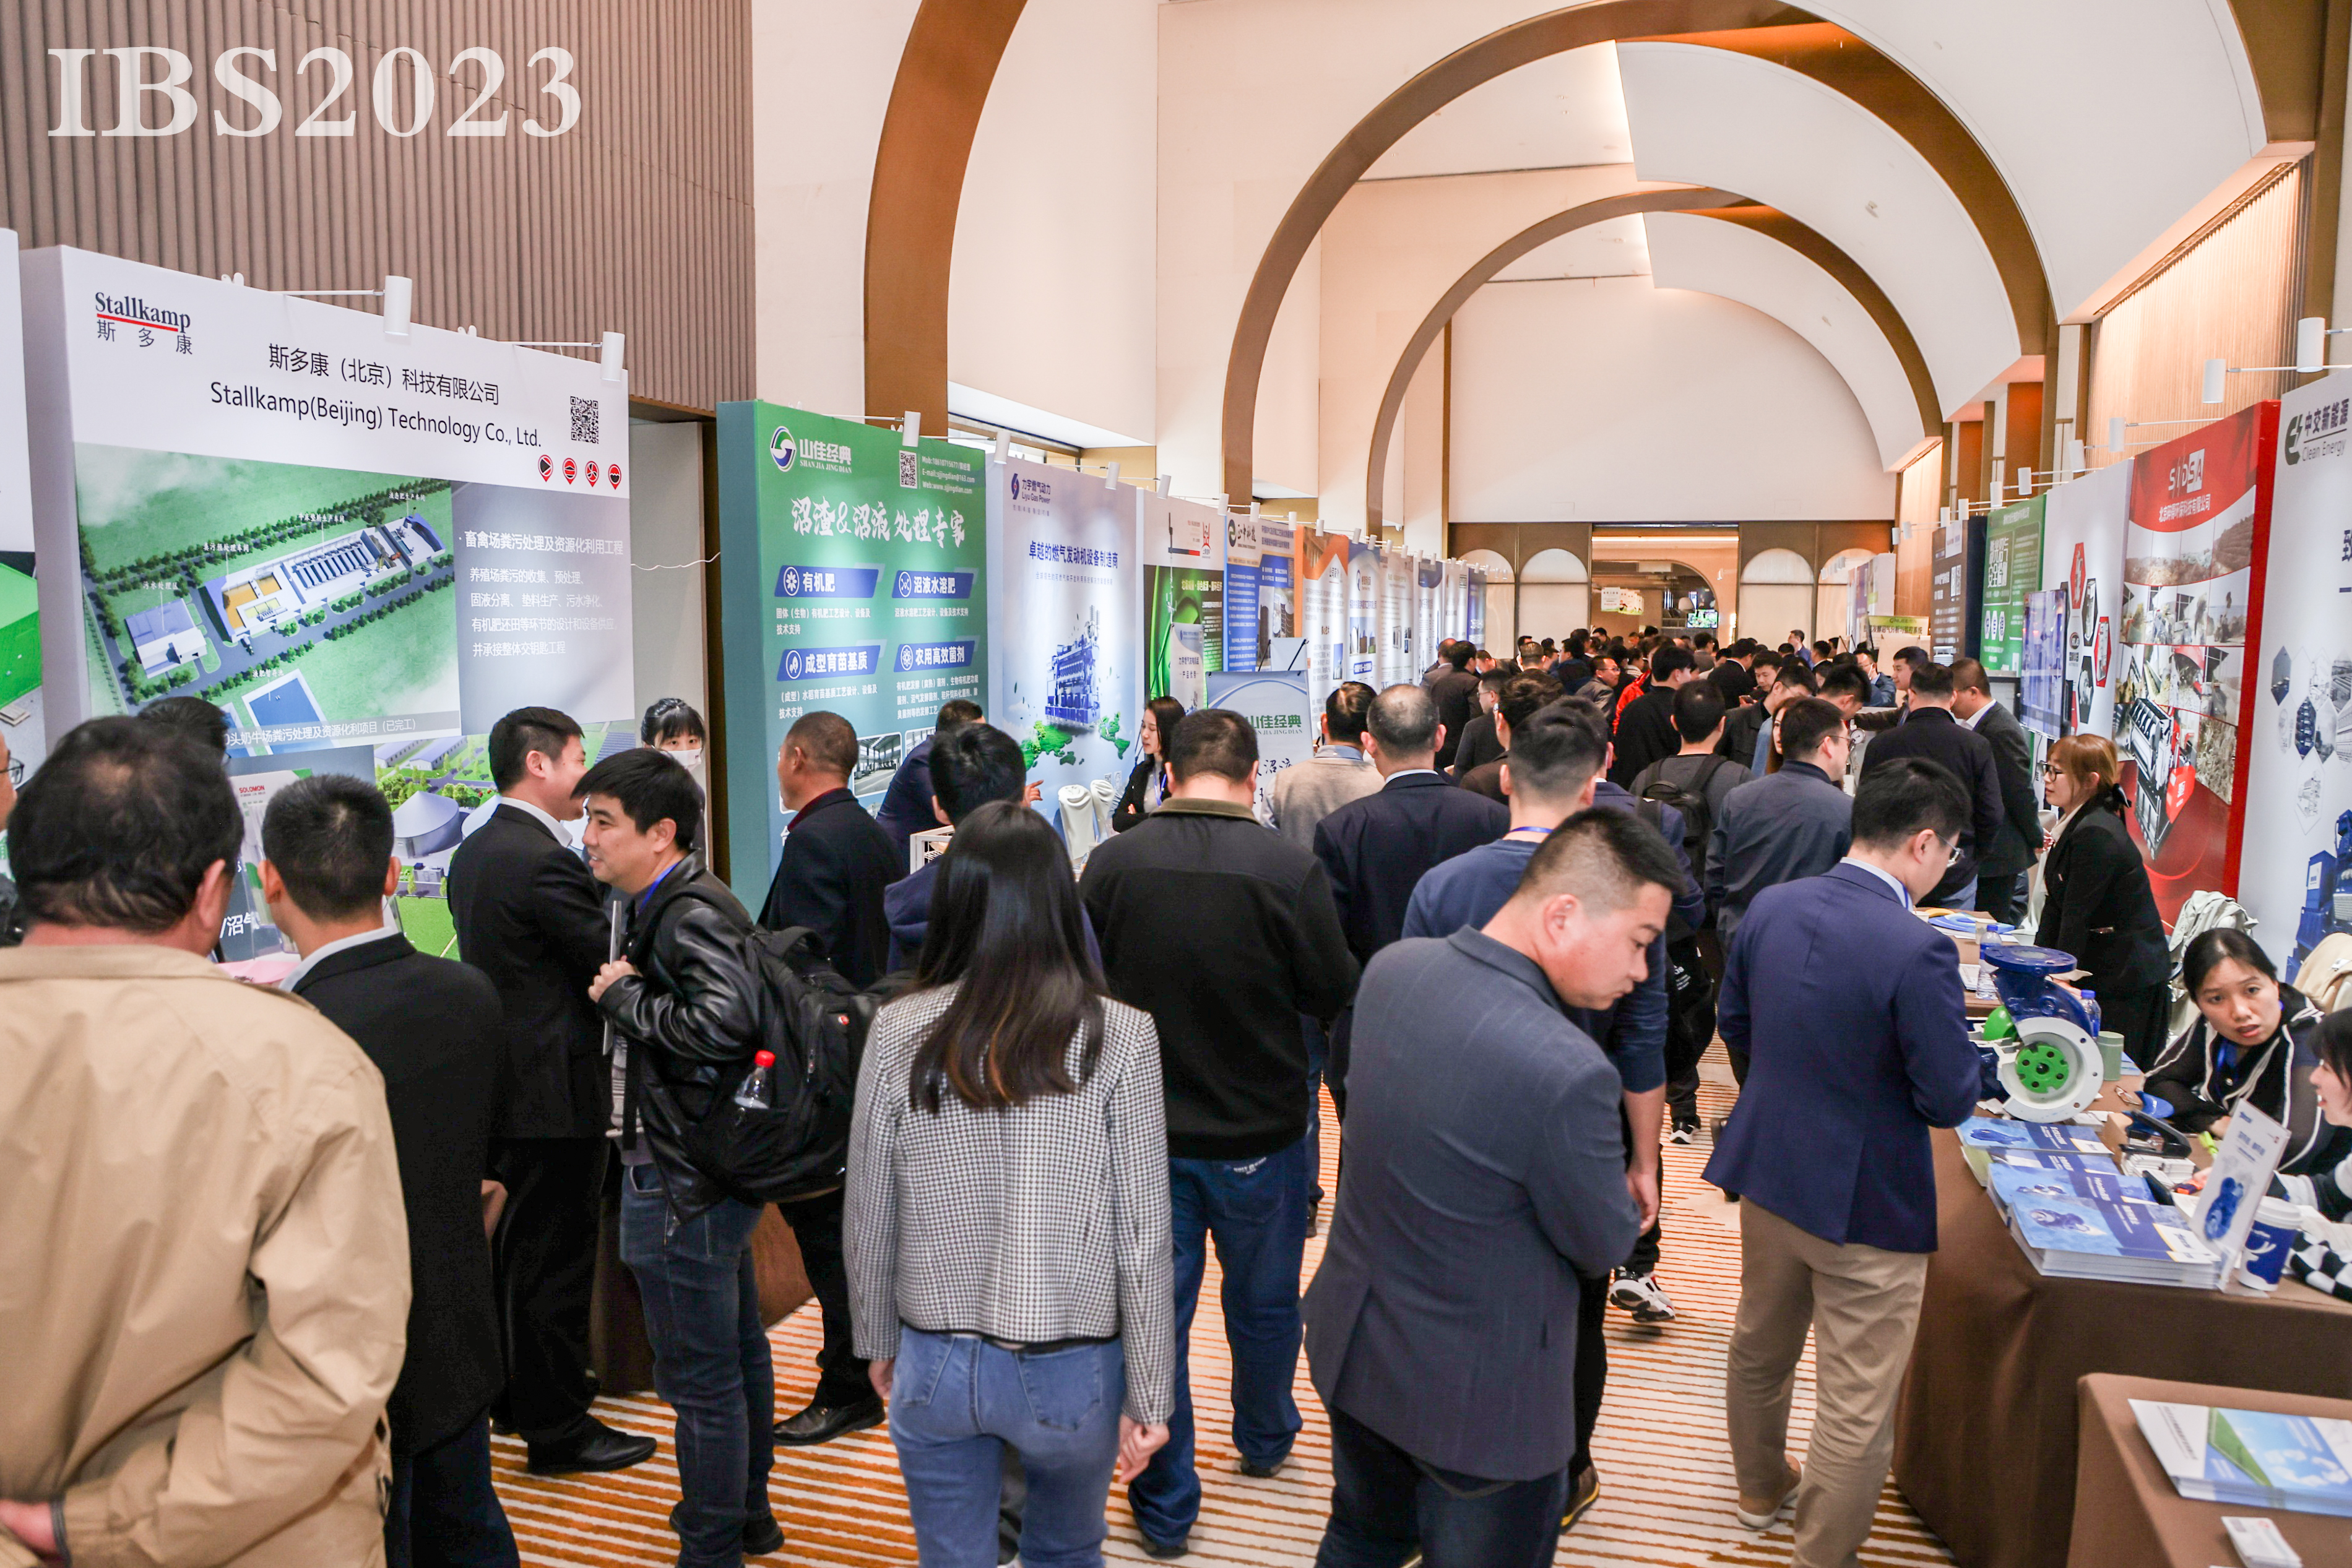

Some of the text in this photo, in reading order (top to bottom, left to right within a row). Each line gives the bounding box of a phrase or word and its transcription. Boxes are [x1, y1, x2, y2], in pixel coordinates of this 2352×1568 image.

[95, 291, 191, 334] Stallkamp
[97, 320, 193, 356] 斯多康
[269, 343, 499, 405] 斯多康（北京）科技有限公司
[211, 382, 542, 447] Stallkamp(Beijing) Technology Co., Ltd.
[800, 438, 852, 465] 山佳经典
[2322, 439, 2346, 457] Energy
[800, 460, 852, 473] SHAN JIA JING DIAN
[2168, 458, 2202, 491] SIDSA
[1022, 478, 1051, 495] 力宇燃气动力
[1022, 492, 1051, 504] Liyu Gas Power
[464, 530, 623, 555] 畜禽场粪污处理及资源化利用工程
[1029, 540, 1118, 569] 卓越的燃气发动机设备制造商
[803, 571, 835, 593] 有机肥
[914, 576, 956, 595] 沼液水溶肥
[776, 624, 801, 635] 技术支持
[473, 641, 566, 657] 并承接整体交钥匙工程
[915, 645, 965, 666] 农用高效菌剂
[805, 651, 868, 674] 成型育苗基质
[779, 706, 803, 719] 技术支持
[1245, 715, 1302, 729] 山佳经典
[239, 785, 265, 793] SOLOMON
